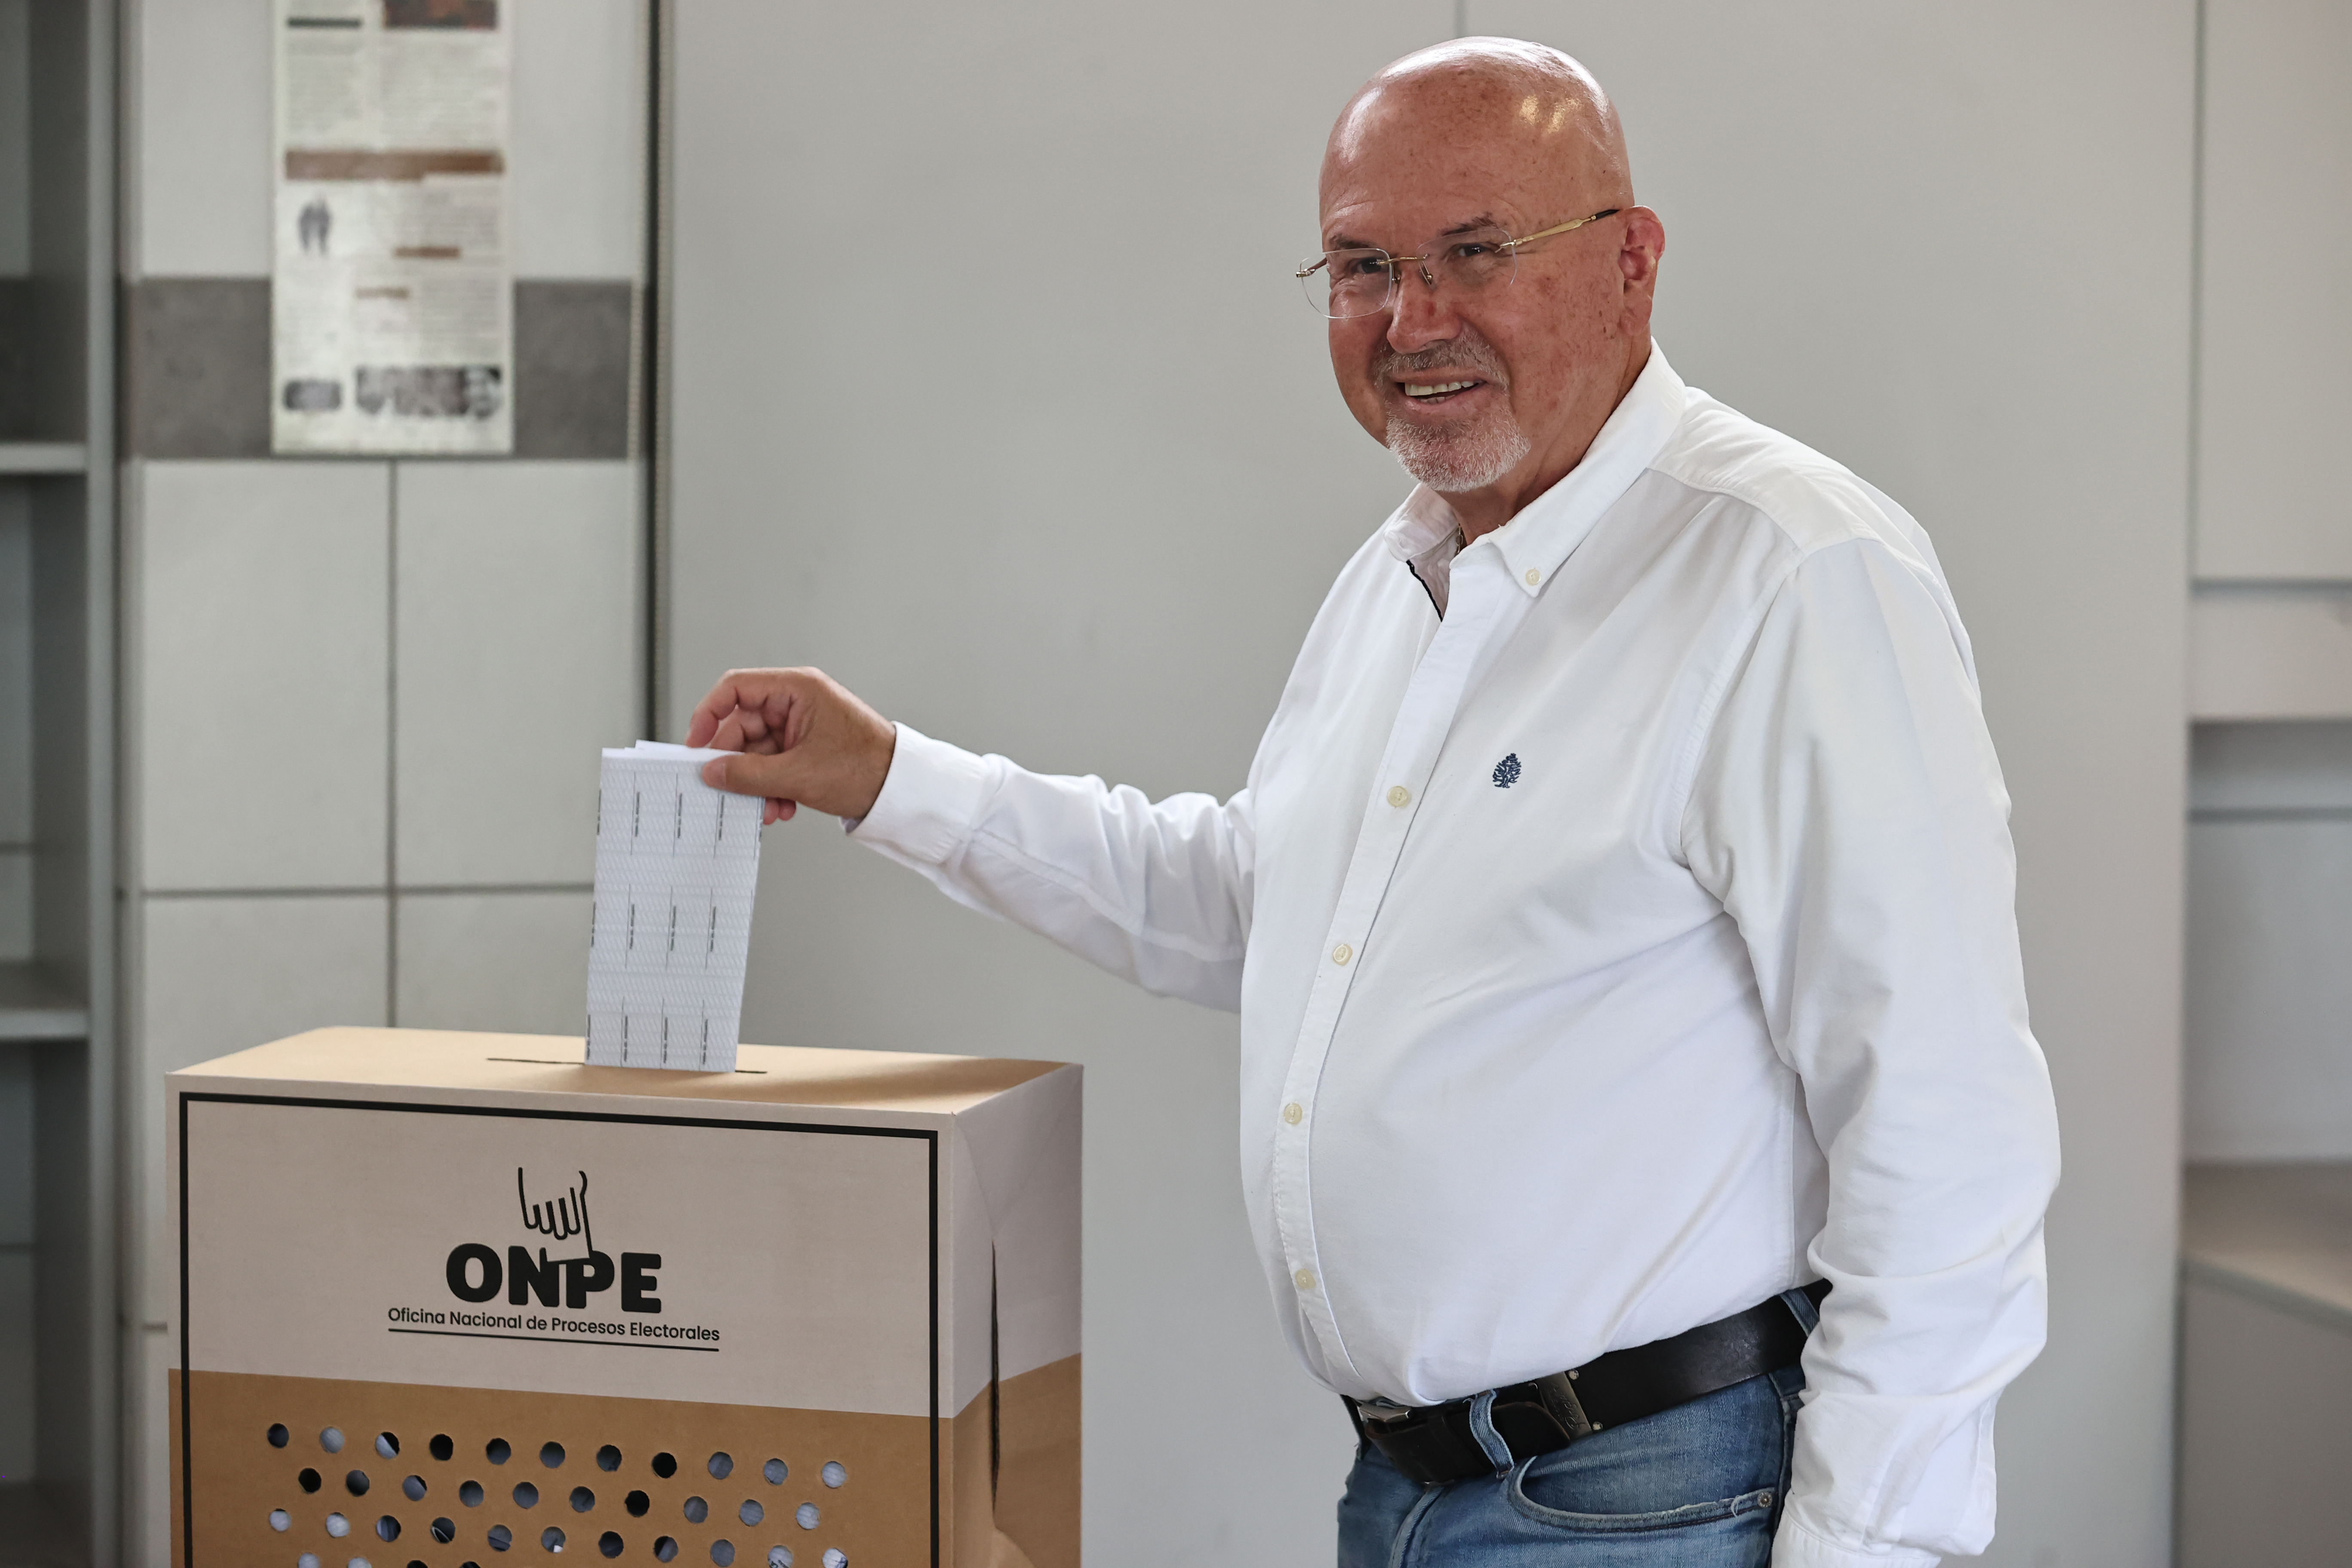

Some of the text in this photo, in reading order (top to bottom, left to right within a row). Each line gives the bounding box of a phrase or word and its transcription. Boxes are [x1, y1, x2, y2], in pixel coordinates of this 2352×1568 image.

[446, 1243, 662, 1314] ONPE
[388, 1308, 720, 1341] Oficina Nacional de Procesos Electorales
